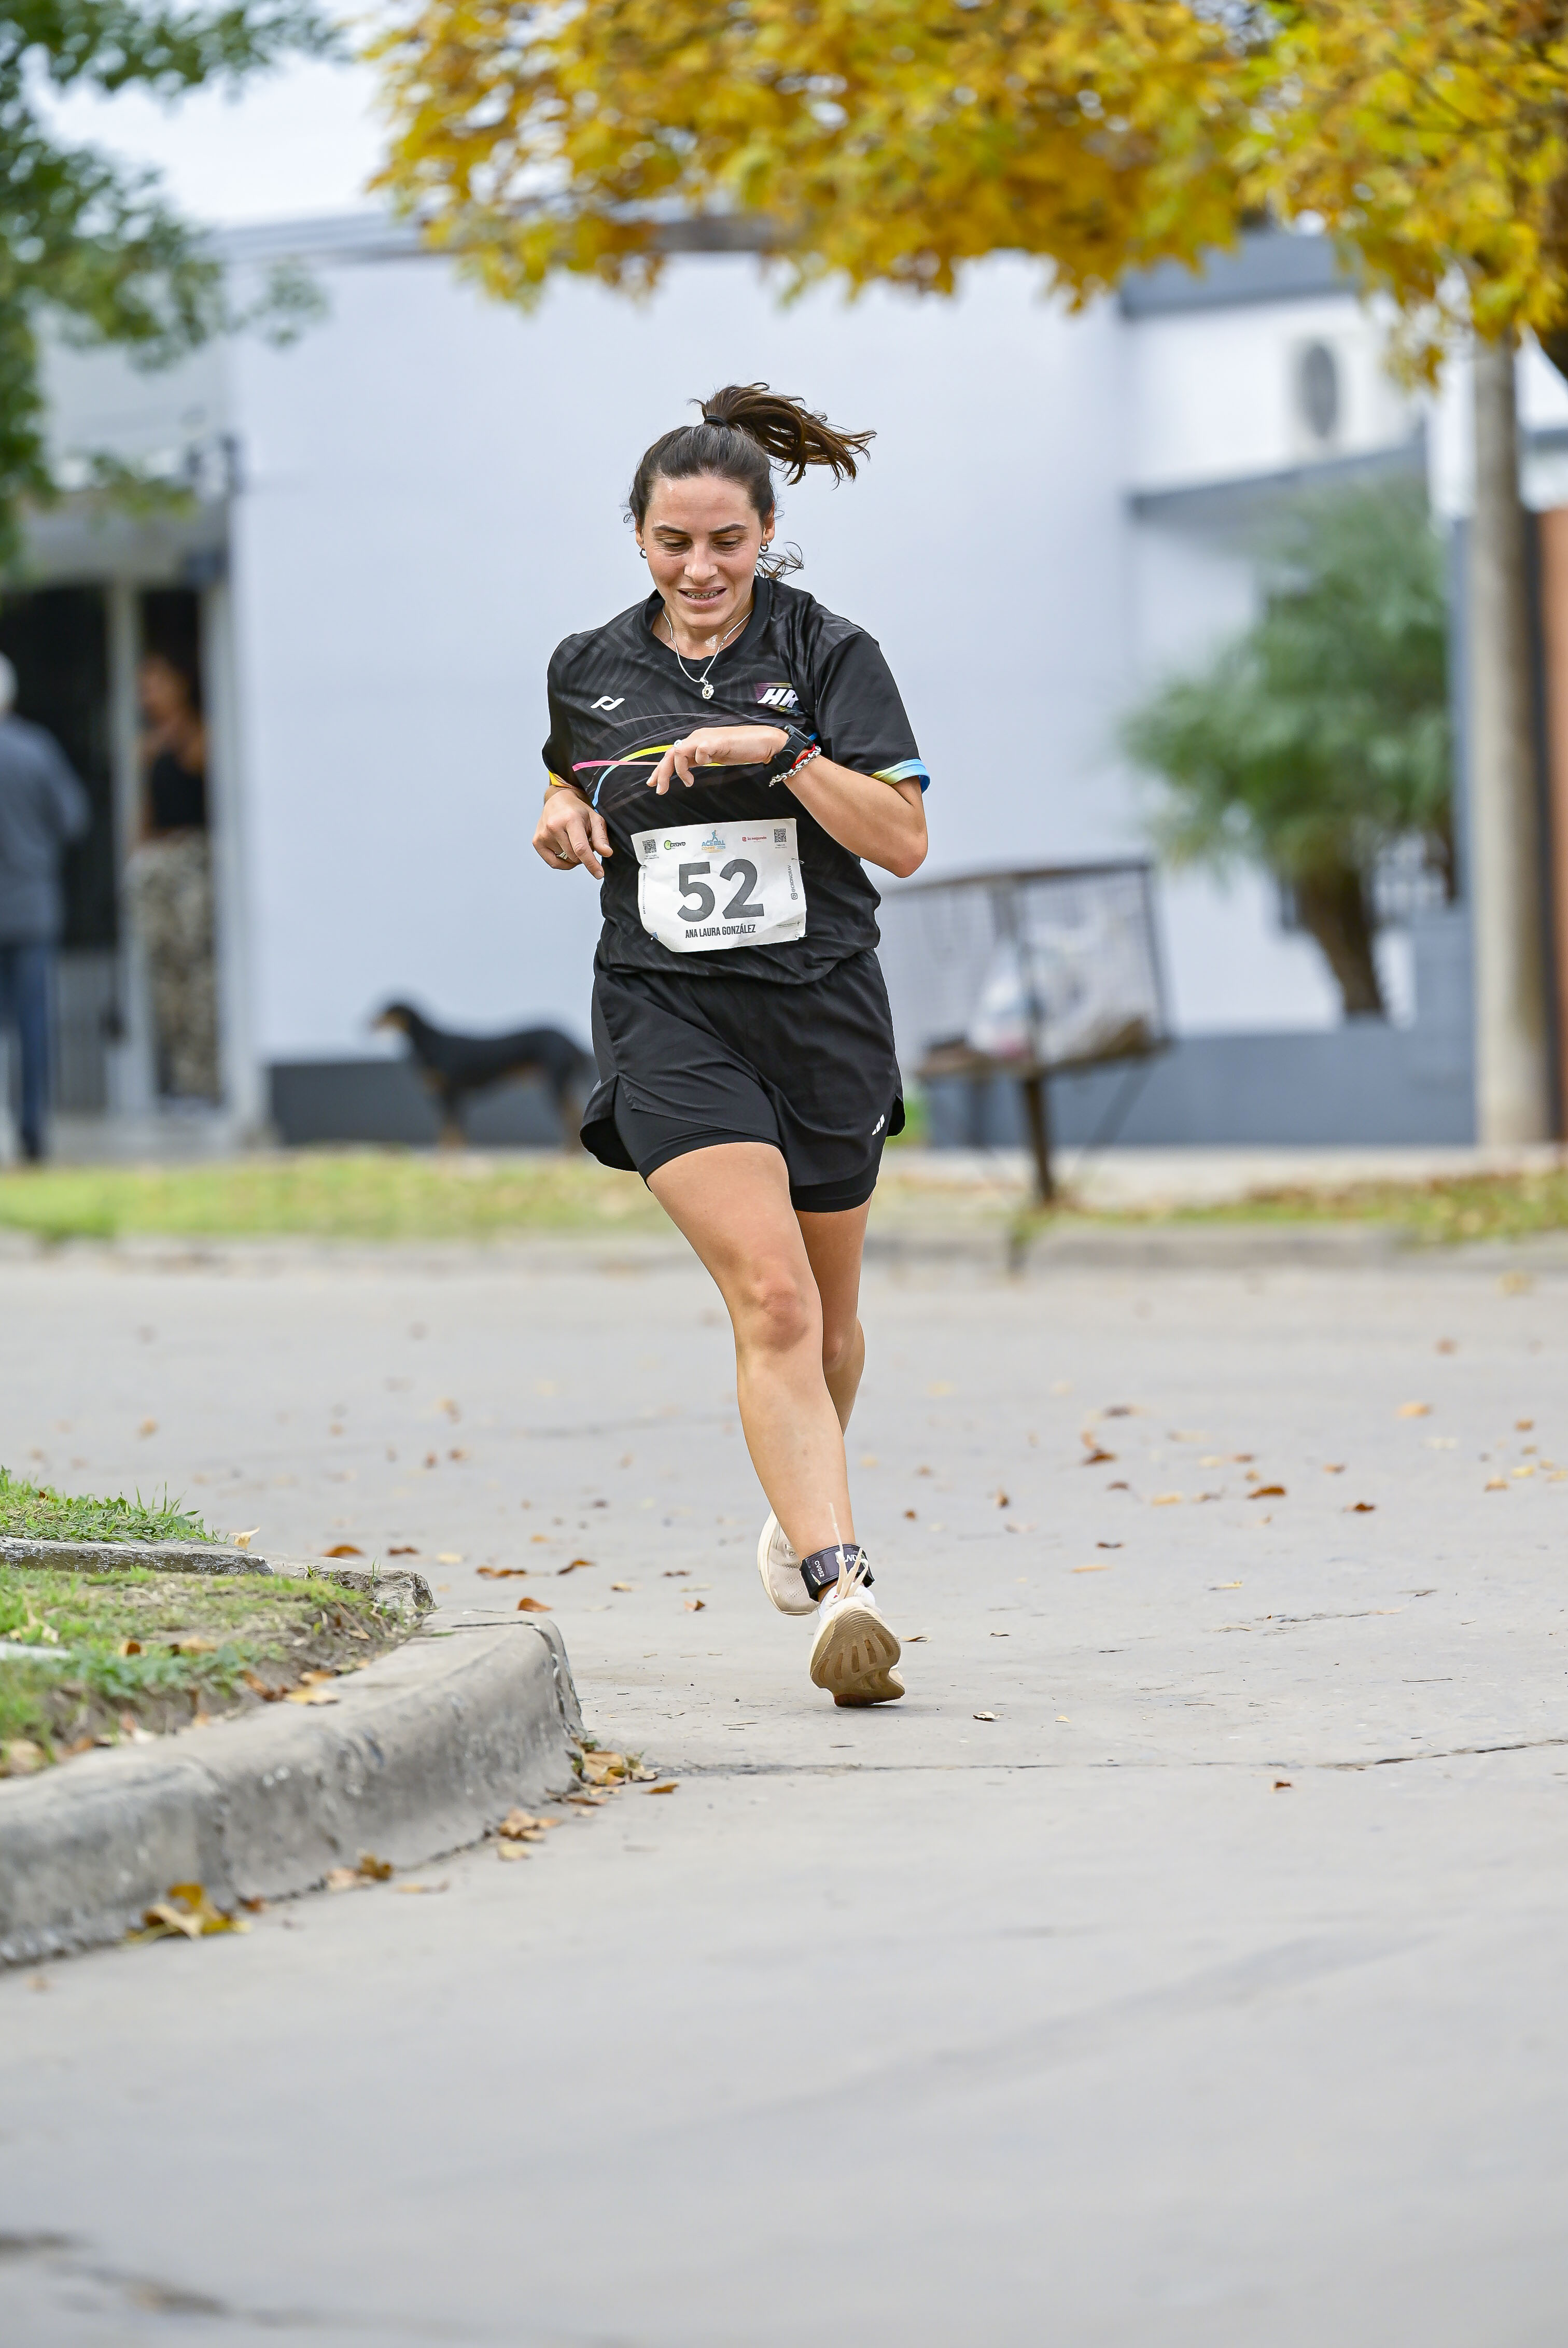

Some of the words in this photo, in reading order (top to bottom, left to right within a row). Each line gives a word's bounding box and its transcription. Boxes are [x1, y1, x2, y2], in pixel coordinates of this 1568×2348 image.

[677, 859, 764, 922] 52
[685, 929, 698, 938] ANA
[699, 927, 721, 937] LAURA
[722, 923, 756, 935] GONZÁLEZ
[814, 1560, 825, 1577] CV052
